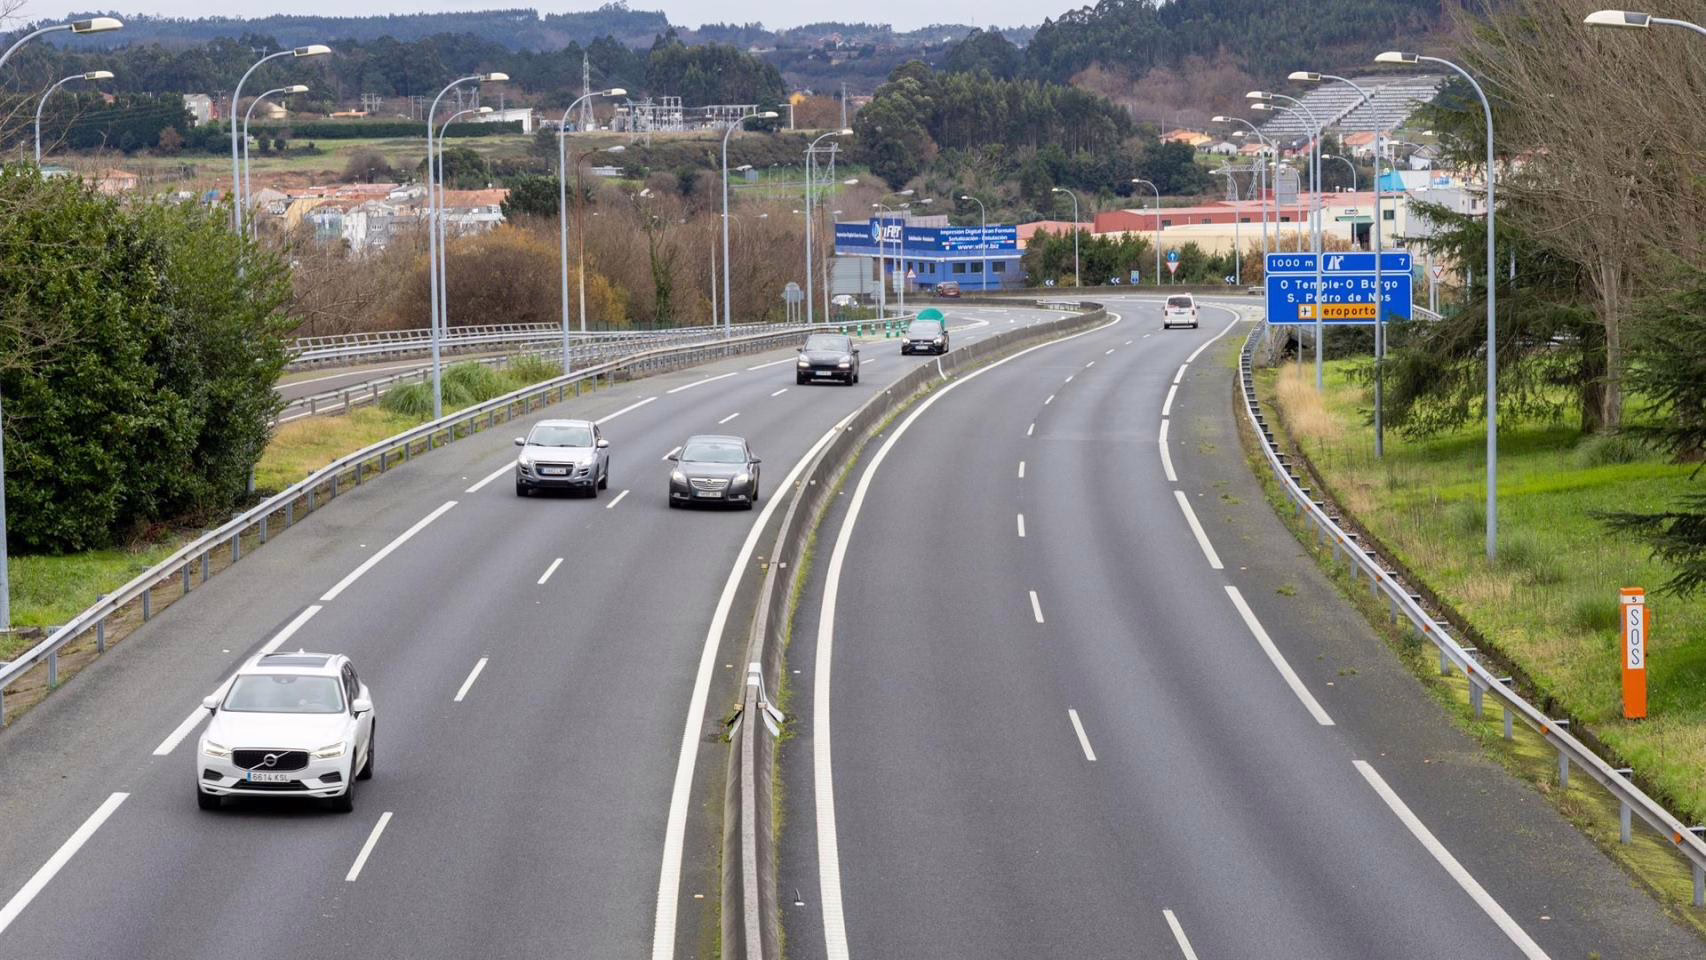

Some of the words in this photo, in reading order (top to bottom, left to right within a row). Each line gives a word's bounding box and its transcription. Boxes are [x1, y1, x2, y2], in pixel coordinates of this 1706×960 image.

[1272, 259, 1300, 267] 1000
[1399, 258, 1405, 266] 7
[1280, 280, 1289, 289] O
[1361, 279, 1398, 291] Bugo
[1287, 293, 1300, 303] S.
[1347, 293, 1362, 302] de
[1323, 307, 1376, 318] eroporto
[1631, 609, 1639, 665] SOS
[252, 773, 272, 781] 6614
